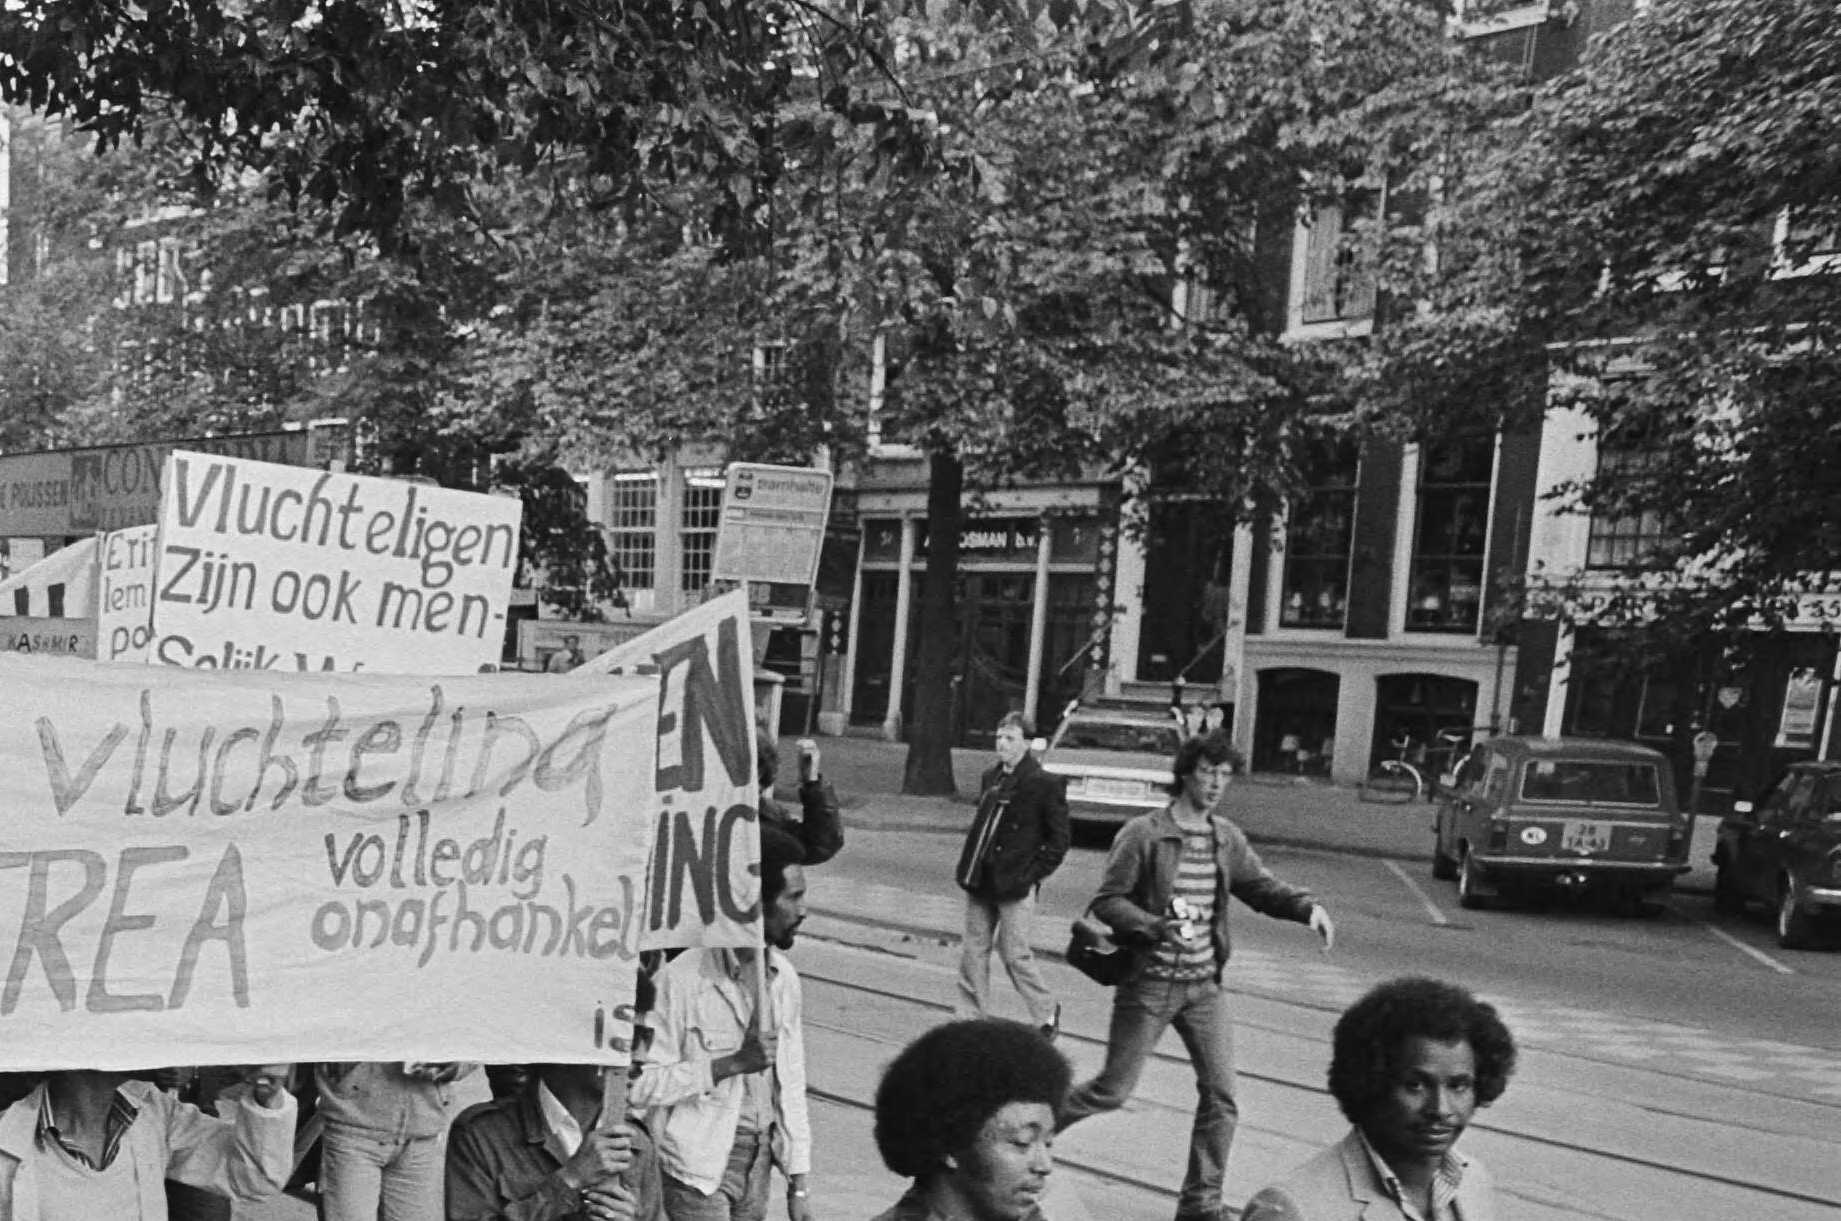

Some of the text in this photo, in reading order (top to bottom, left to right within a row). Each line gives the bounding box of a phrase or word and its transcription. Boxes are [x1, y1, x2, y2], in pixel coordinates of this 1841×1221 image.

[174, 458, 515, 589] Vluchteligen
[159, 544, 258, 615] Zijn
[271, 569, 362, 625] ook
[7, 633, 79, 653] KASHMIR
[33, 683, 618, 829] vluchteling
[323, 805, 549, 901] volledig
